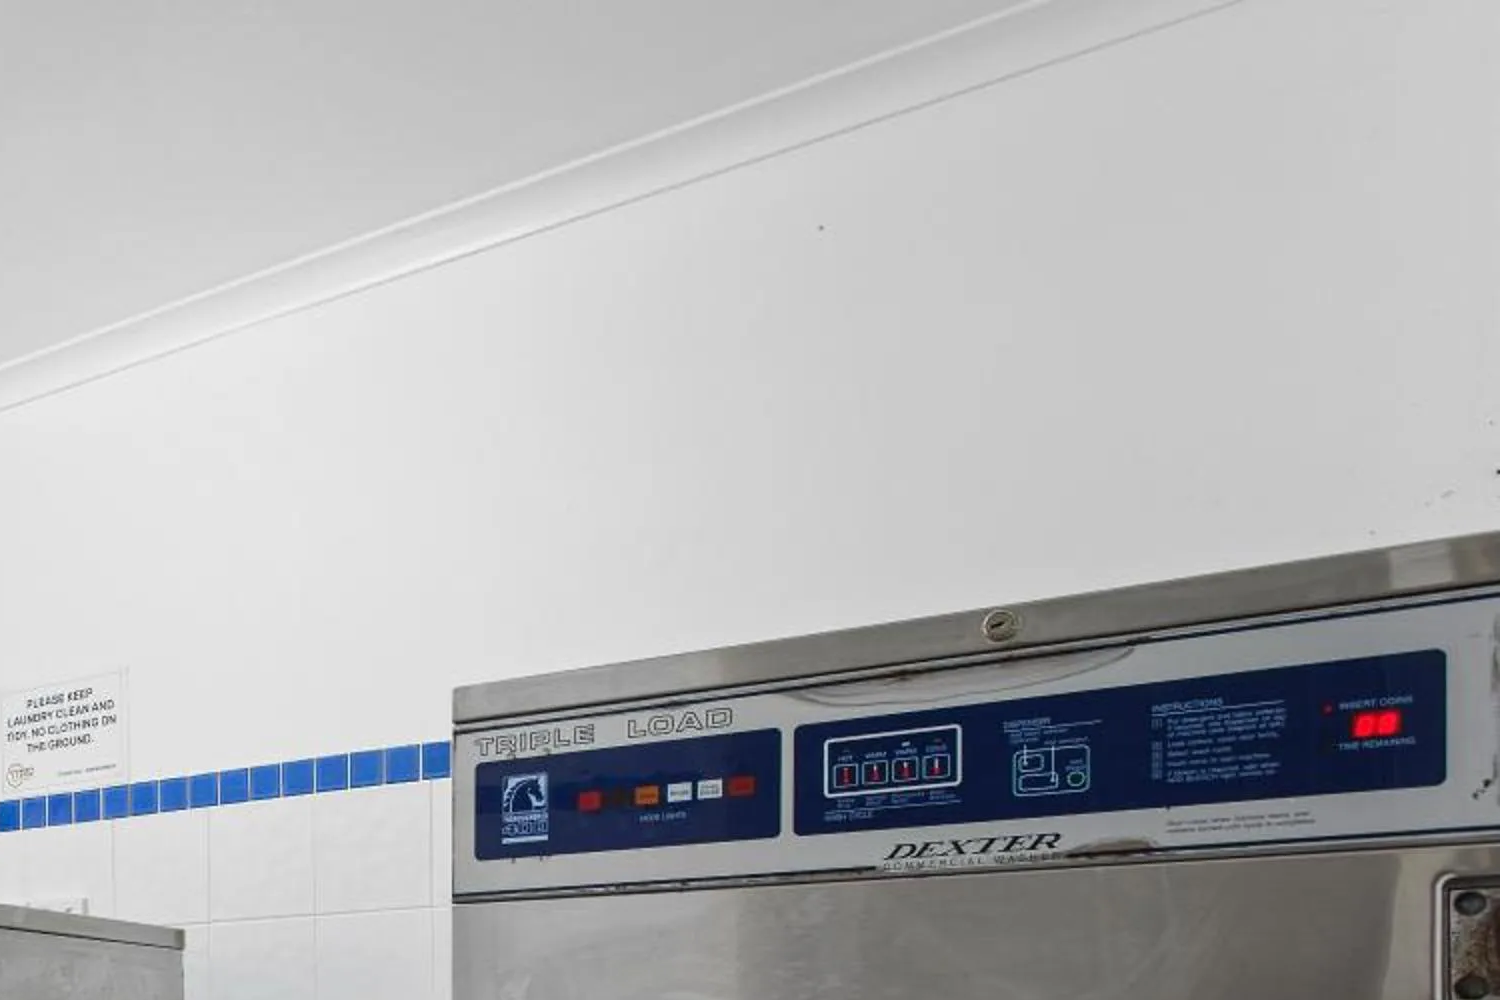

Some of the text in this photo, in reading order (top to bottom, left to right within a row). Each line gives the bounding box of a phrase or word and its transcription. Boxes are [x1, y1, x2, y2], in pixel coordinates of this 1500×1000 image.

[26, 687, 93, 709] PLEASE KEEP
[7, 699, 115, 728] LAUNDRY CLEAN AND
[31, 727, 46, 738] NO
[48, 718, 99, 735] CLOTHING
[102, 714, 117, 727] ON
[475, 707, 733, 757] TRIPLE LOAD
[27, 734, 94, 753] THE GROUND.
[1362, 735, 1417, 749] REMAINING
[884, 832, 1061, 860] DEXTER
[884, 858, 984, 870] COMMERCIAL
